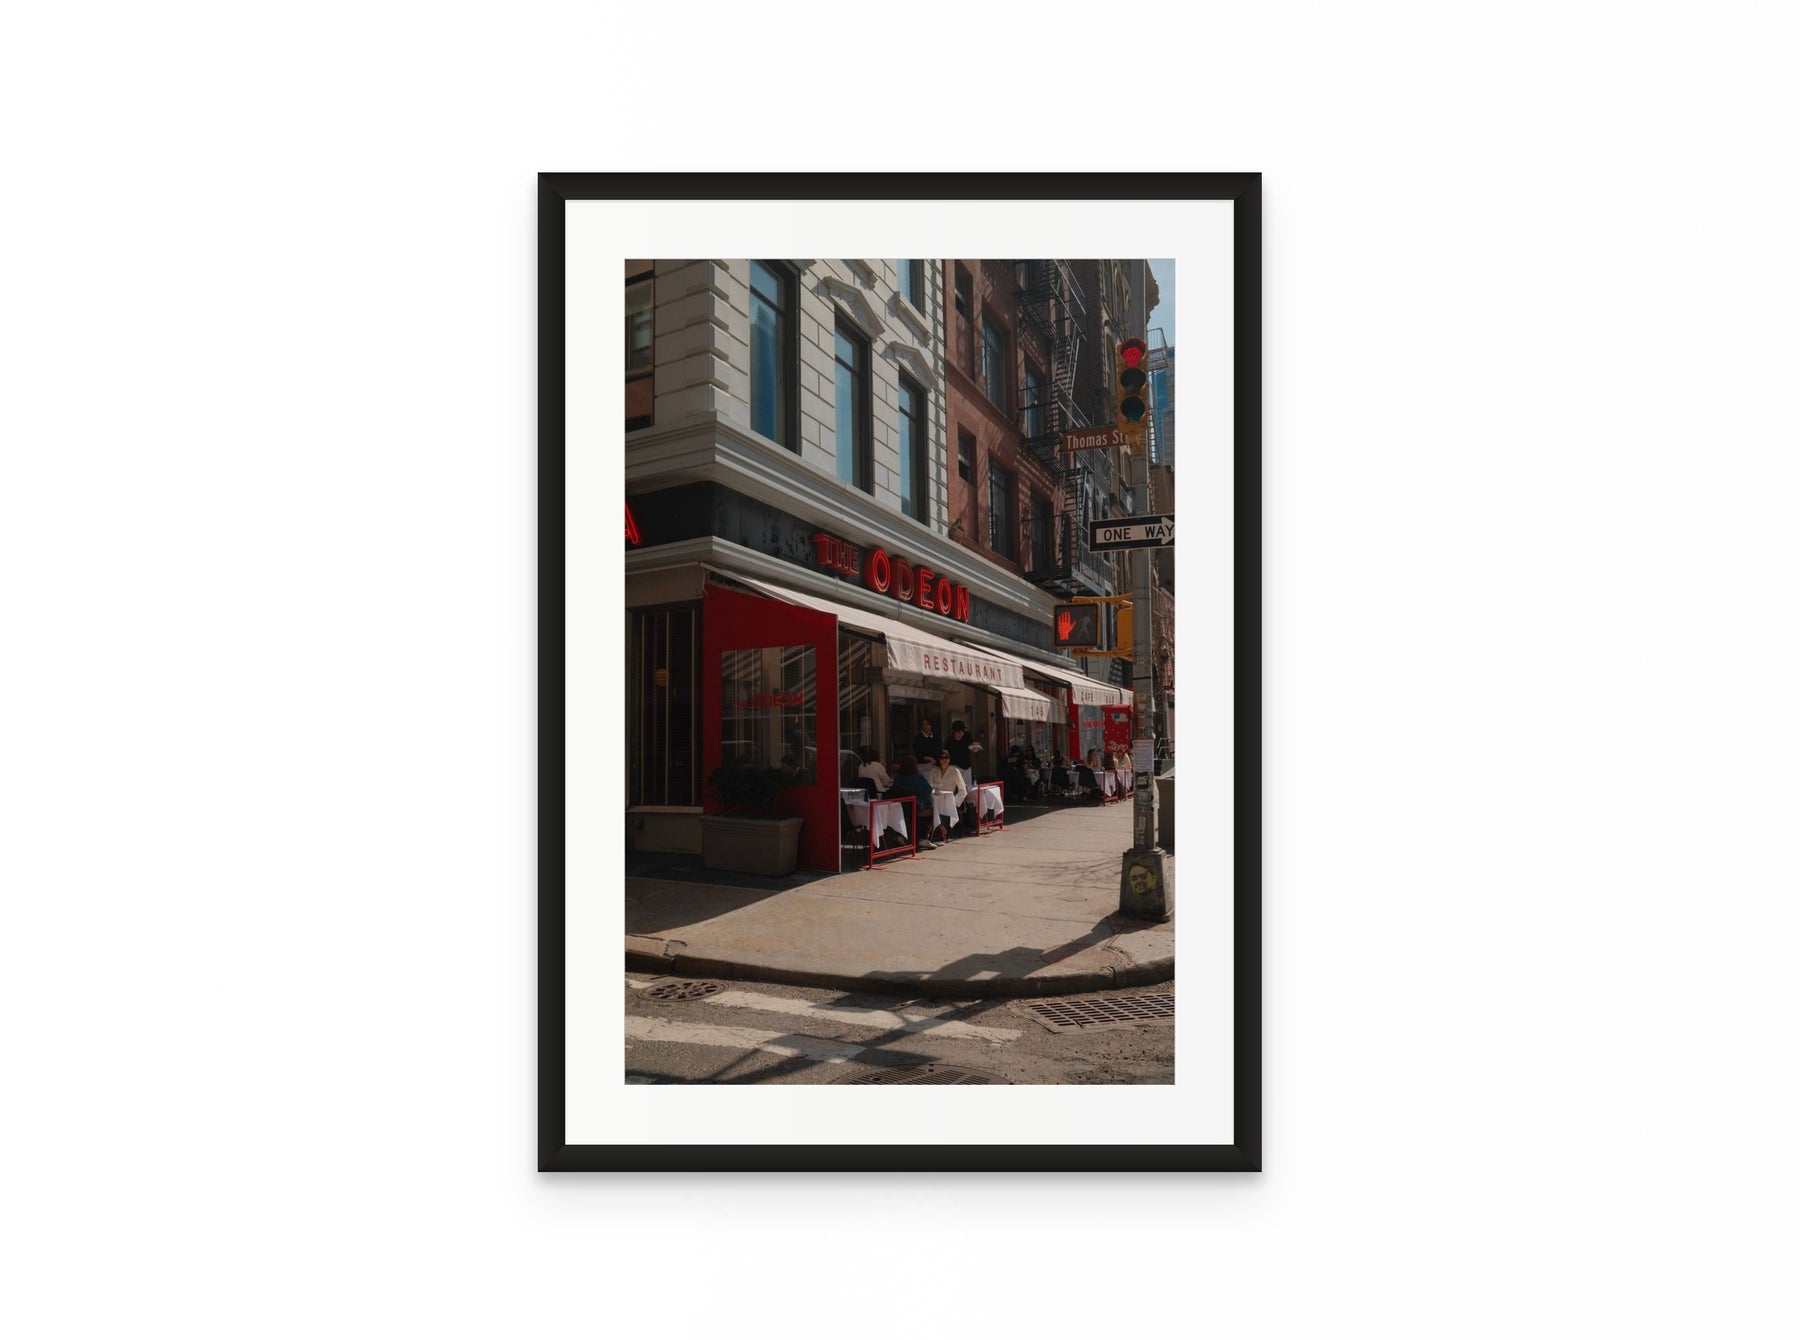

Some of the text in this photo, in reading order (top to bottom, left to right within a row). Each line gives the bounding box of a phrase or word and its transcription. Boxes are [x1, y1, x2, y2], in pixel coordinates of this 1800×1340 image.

[1066, 433, 1108, 450] Thomas
[1103, 524, 1175, 542] ONE WAY
[812, 532, 970, 624] THE ODEON
[923, 654, 1002, 681] RESTAURANT
